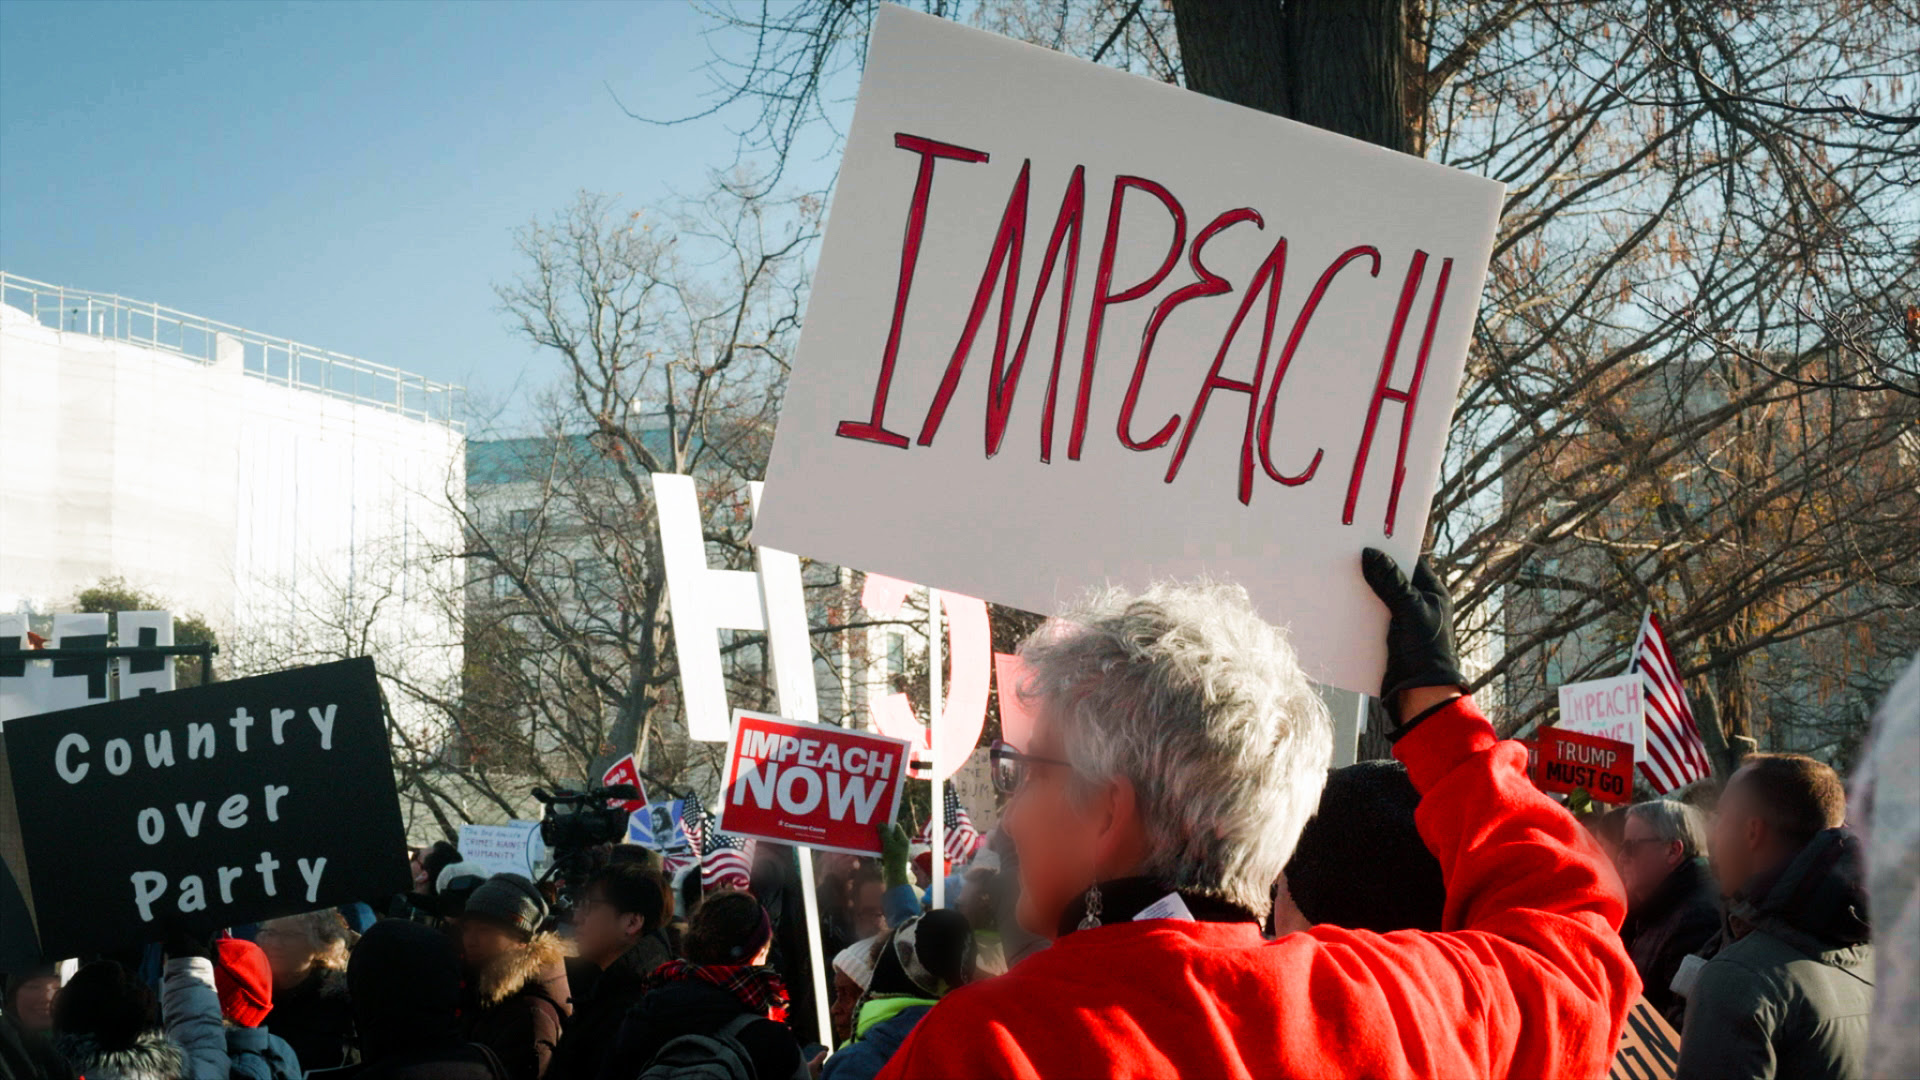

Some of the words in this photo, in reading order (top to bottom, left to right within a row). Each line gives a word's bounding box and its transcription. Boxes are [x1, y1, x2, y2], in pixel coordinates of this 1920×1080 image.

[836, 132, 1453, 537] IMPEACH
[1563, 683, 1640, 725] IMPEACH
[55, 704, 338, 784] Country
[741, 729, 893, 780] IMPEACH
[1556, 741, 1617, 769] TRUMP
[733, 757, 888, 825] NOW
[1547, 761, 1596, 788] MUST
[1600, 772, 1624, 795] GO
[137, 785, 289, 845] over
[467, 850, 515, 859] HUMANITY
[130, 852, 327, 922] Party
